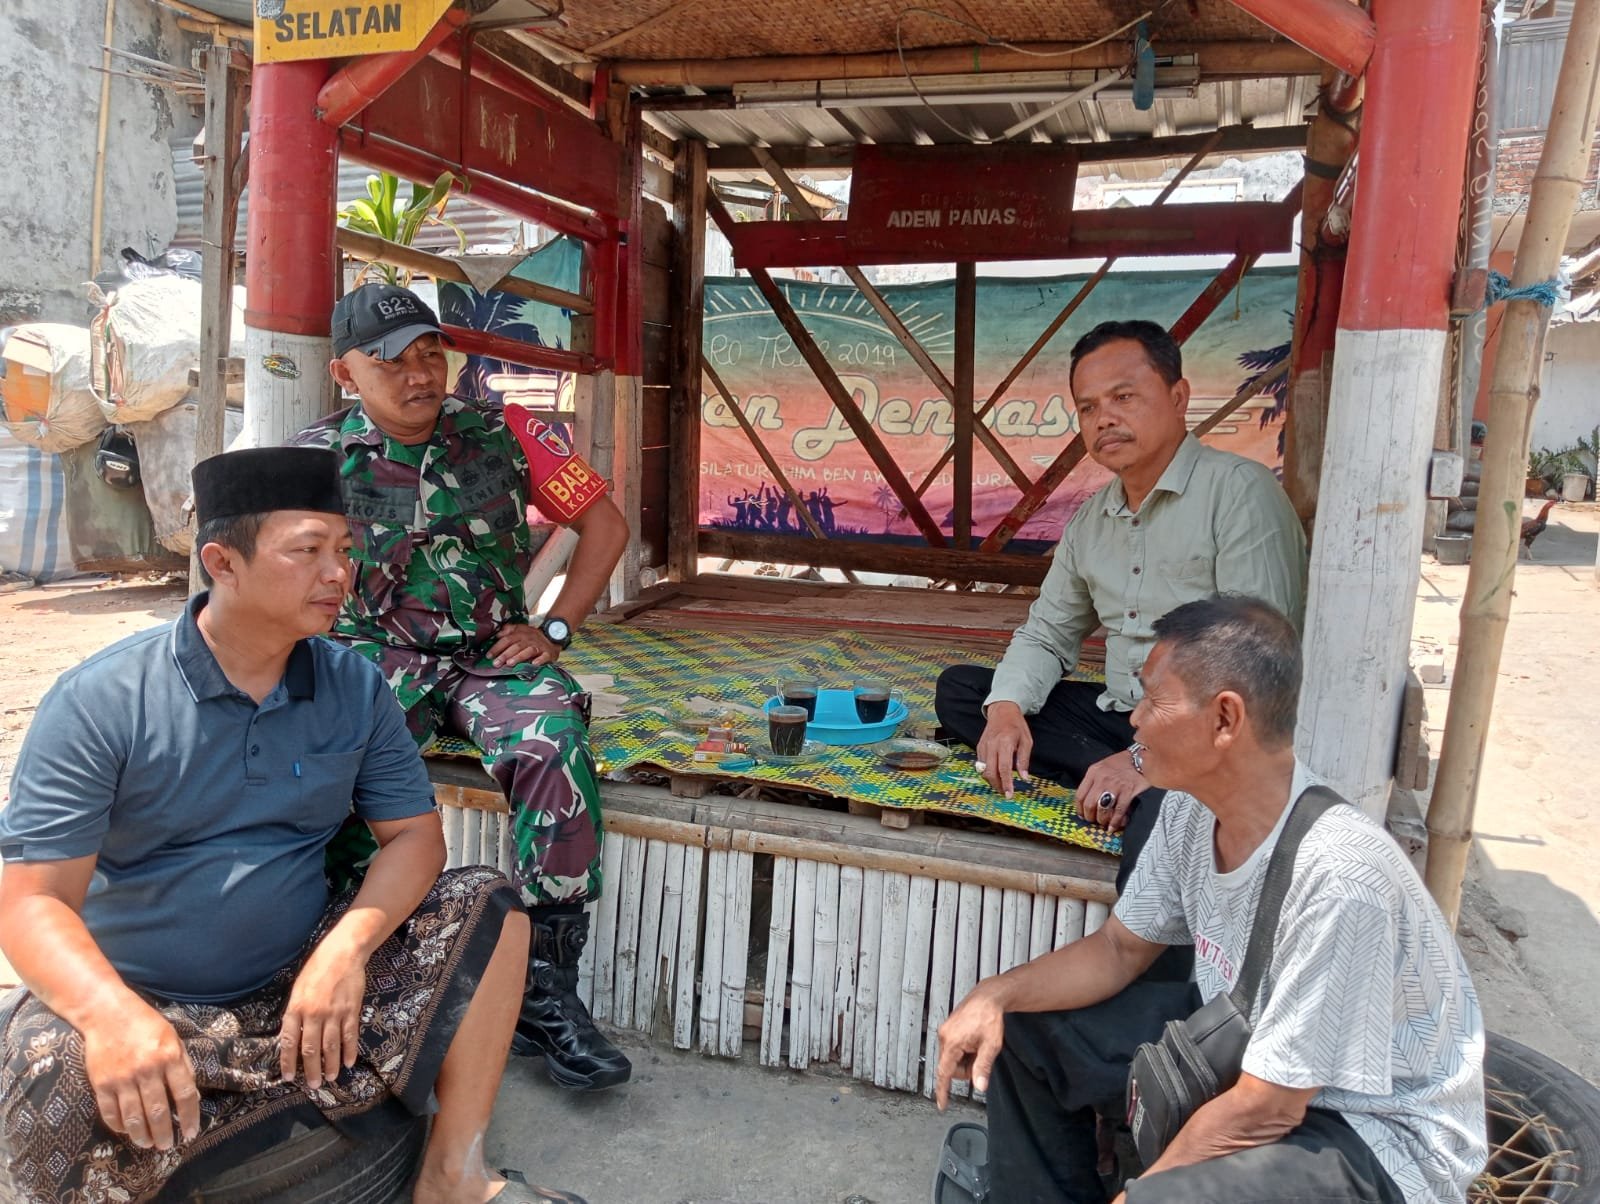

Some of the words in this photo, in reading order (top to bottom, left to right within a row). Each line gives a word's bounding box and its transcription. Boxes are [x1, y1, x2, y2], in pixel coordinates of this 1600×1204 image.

[275, 4, 402, 43] SELATAN
[886, 209, 942, 229] ADEM
[949, 207, 1018, 227] PANAS
[378, 296, 415, 316] 623
[704, 334, 742, 367] RO
[838, 342, 897, 367] 2019
[701, 391, 785, 431] an
[823, 467, 857, 482] BEN
